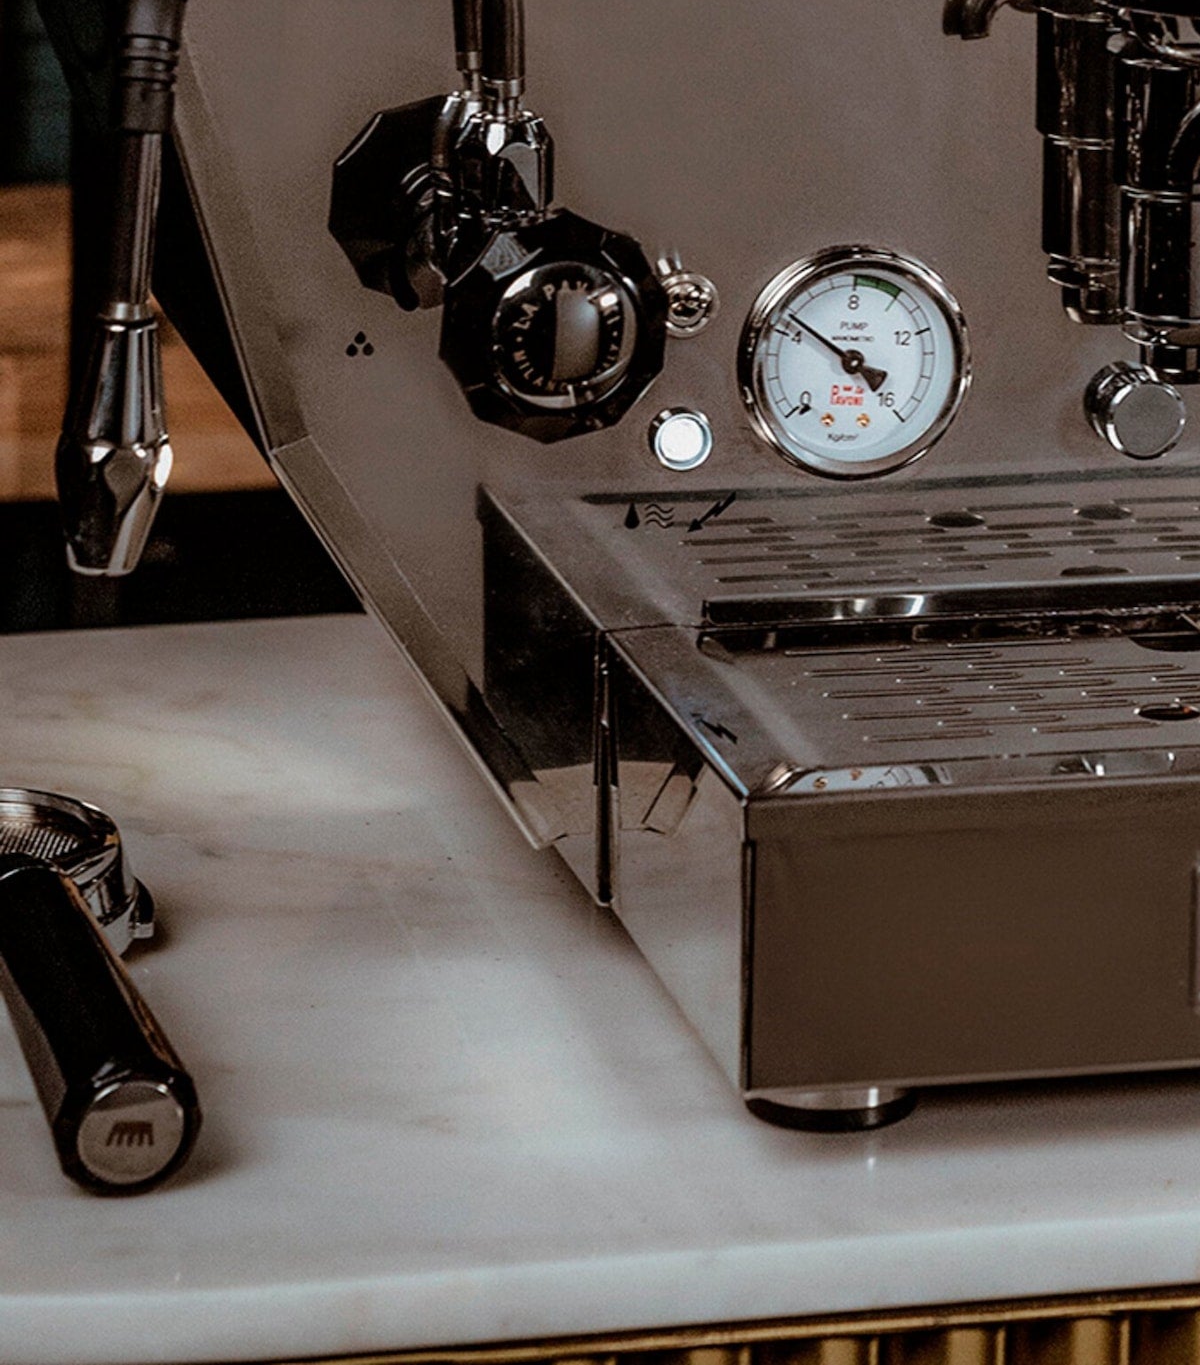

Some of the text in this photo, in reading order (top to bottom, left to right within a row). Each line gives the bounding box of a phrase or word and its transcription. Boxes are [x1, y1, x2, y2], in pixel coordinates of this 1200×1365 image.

[847, 294, 860, 310] 8
[791, 330, 802, 344] 4
[894, 330, 911, 346] 12
[877, 392, 895, 408] 16
